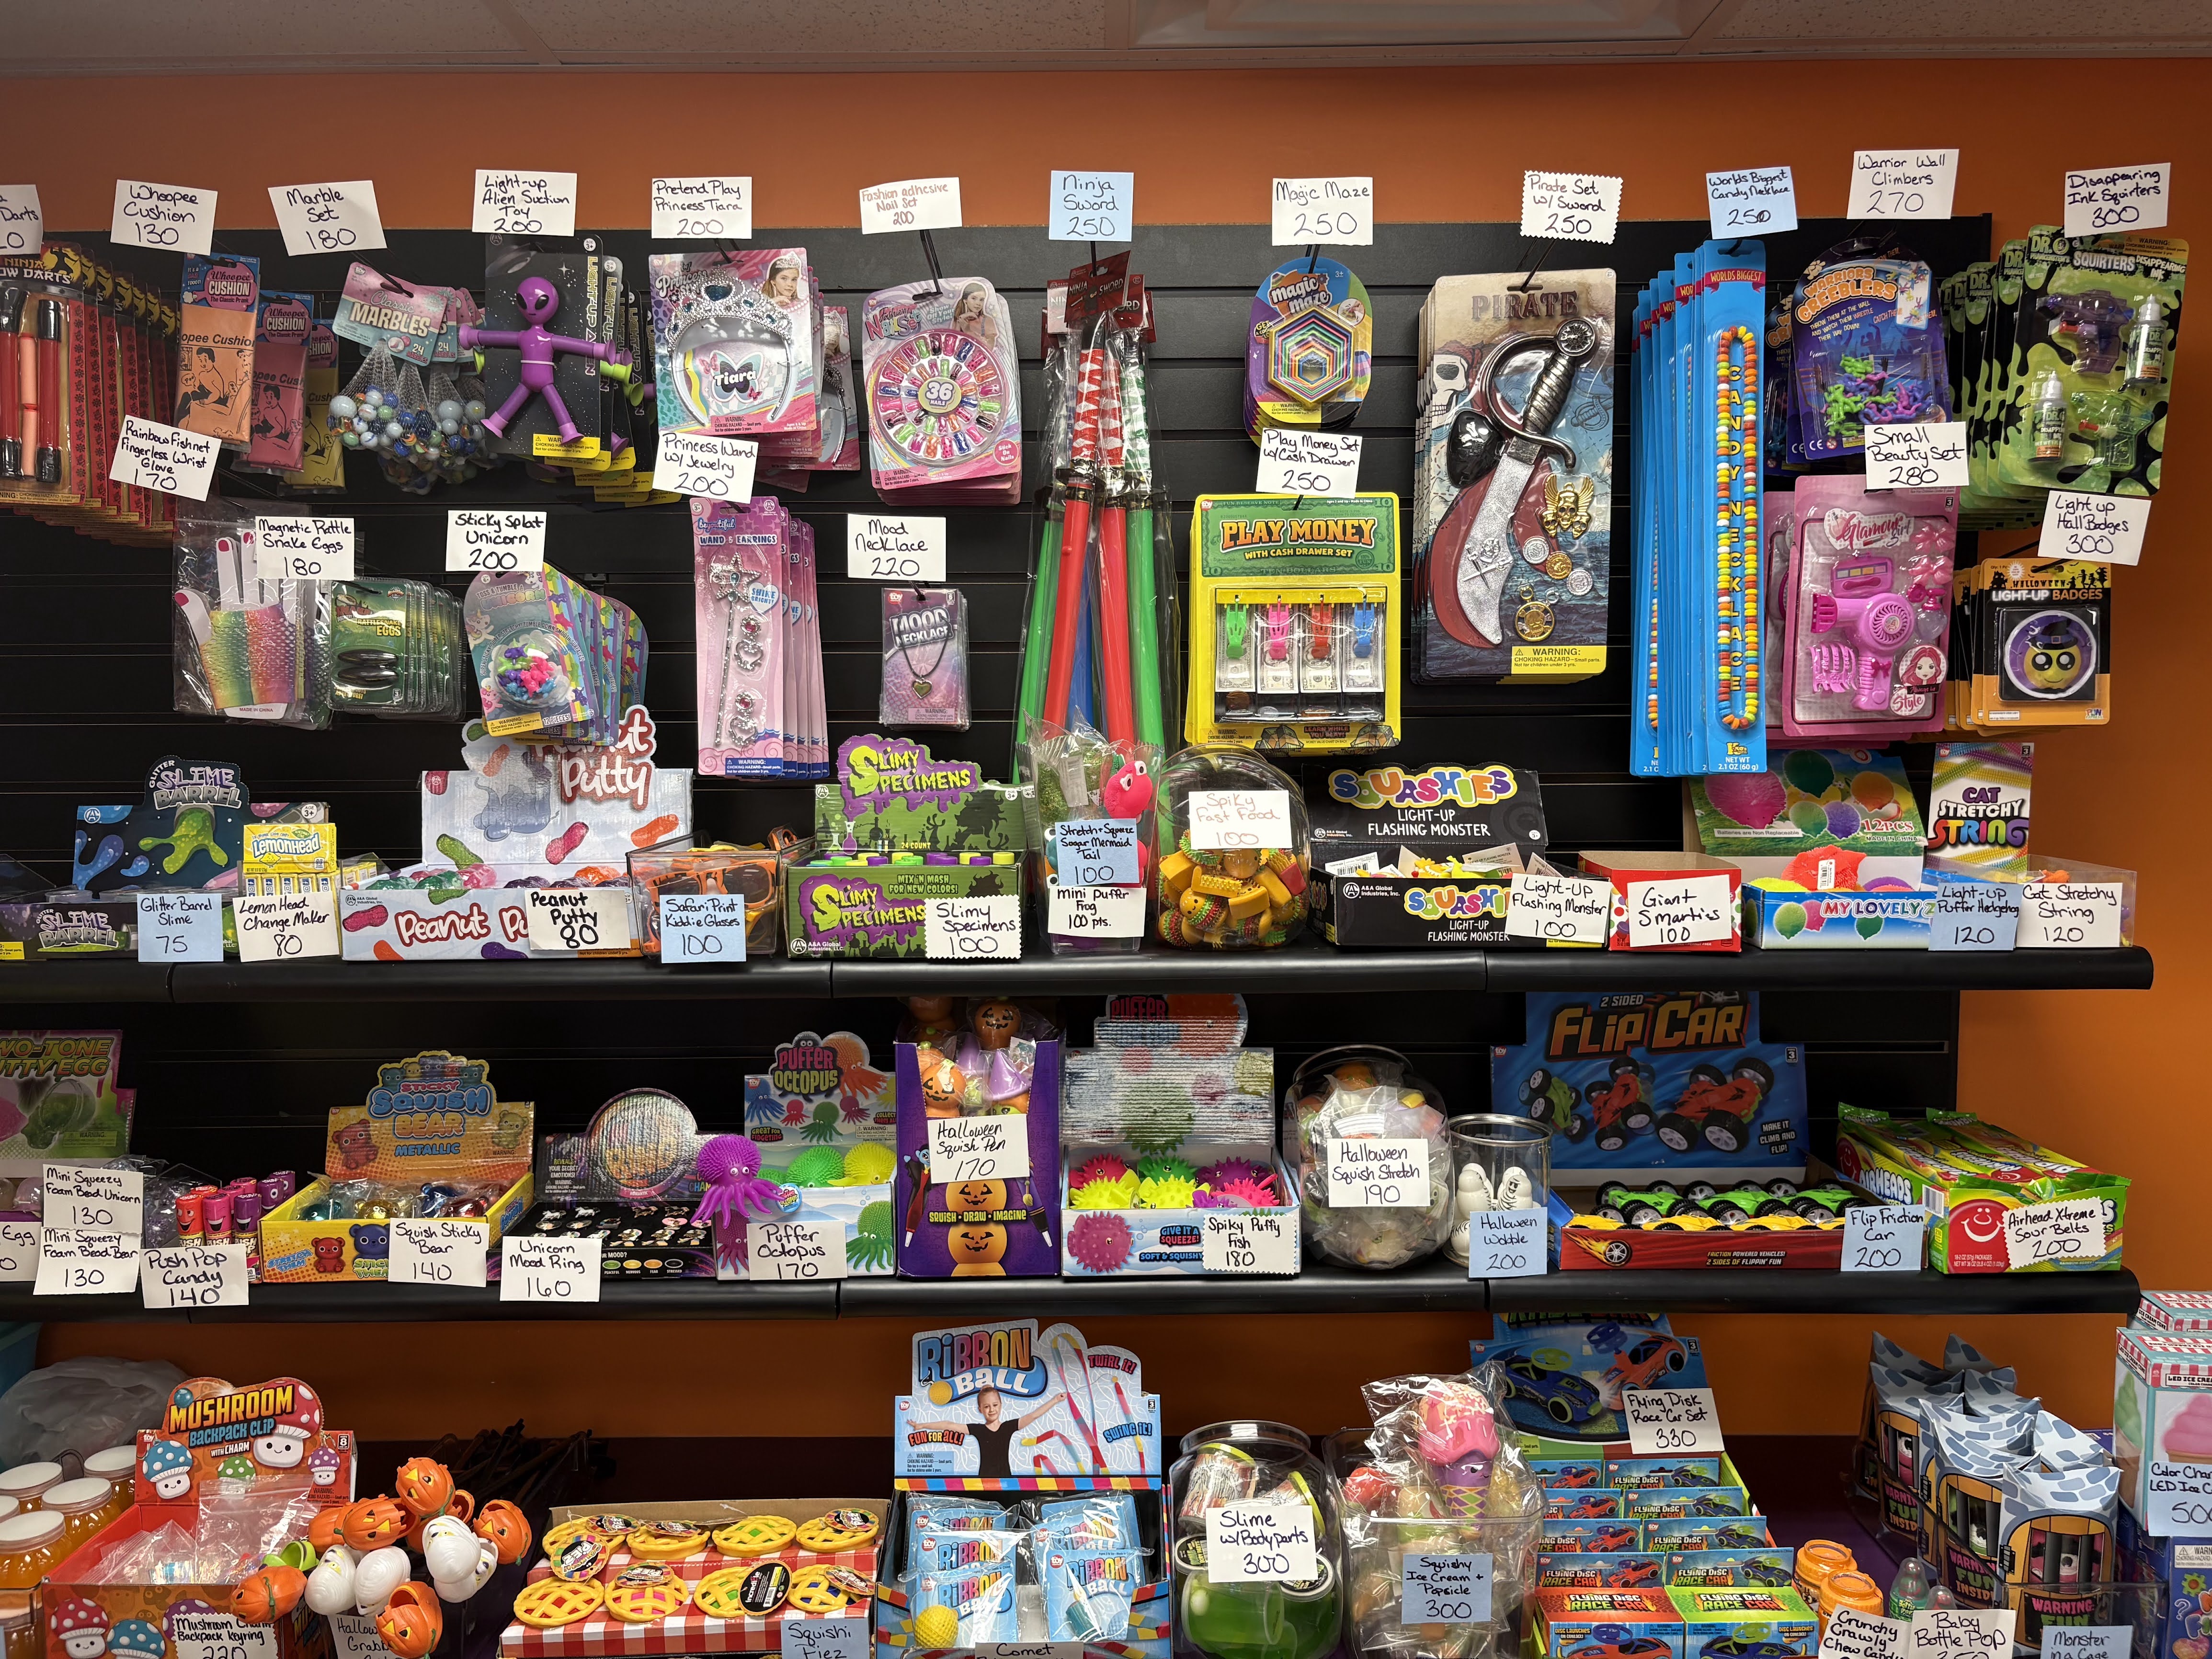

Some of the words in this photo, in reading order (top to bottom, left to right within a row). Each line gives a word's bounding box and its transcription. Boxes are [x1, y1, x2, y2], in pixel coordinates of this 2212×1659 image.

[1858, 154, 1907, 170] Warrior
[1917, 154, 1945, 167] Wall
[1872, 172, 1933, 185] Climbers
[2068, 170, 2160, 189] Disappearing
[129, 189, 199, 205] Whoopee
[287, 189, 344, 206] Marble
[653, 180, 708, 195] Pretend
[709, 180, 740, 200] Play
[1325, 181, 1369, 198] Maze
[2068, 192, 2098, 205] Ink
[2101, 185, 2160, 205] Squirters
[653, 197, 706, 212] Princess
[708, 198, 742, 211] Tiara
[1867, 191, 1924, 214] 270
[124, 202, 195, 222] Cushion
[308, 208, 339, 222] Set
[2093, 206, 2139, 228] 300
[677, 219, 723, 236] 200
[1294, 213, 1357, 235] 250
[136, 223, 179, 245] 130
[307, 228, 356, 249] 180
[2073, 251, 2136, 271] SQUIRTERS
[2136, 256, 2185, 273] DISAPPEARING
[210, 269, 250, 282] Whoopee
[1710, 272, 1735, 282] WORLDS
[1737, 271, 1762, 281] BIGGEST
[1805, 267, 1873, 297] WARRIORS
[208, 281, 250, 296] CUSHION
[371, 290, 414, 313] Classic
[1471, 290, 1578, 321] PIRATE
[1798, 281, 1898, 322] CREEBLERS
[350, 302, 431, 337] MARBLES
[713, 370, 756, 387] Tiara
[925, 385, 951, 400] 36
[259, 520, 311, 534] Magnetic
[314, 521, 352, 534] Rattle
[1222, 523, 1283, 548] PLAY
[1290, 519, 1376, 545] MONEY
[263, 536, 307, 549] Snake
[313, 538, 344, 552] Eggs
[699, 536, 724, 545] WAND
[736, 534, 777, 545] EARRINGS
[1244, 551, 1268, 559] WITH
[1270, 548, 1293, 557] CASH
[285, 558, 321, 577] 180
[2012, 580, 2065, 589] HALLOWEEN
[1728, 500, 1743, 691] NECKLACE
[1992, 590, 2049, 601] LIGHT-UP
[2052, 589, 2102, 600] BADGES
[1533, 648, 1581, 656] WARNING:
[149, 760, 174, 788] GLITTER
[157, 767, 235, 789] SLIME
[154, 787, 241, 809] BARREL
[1962, 787, 2000, 803] CAT
[1398, 809, 1455, 822] LIGHT-UP
[1939, 799, 2024, 817] STRETCHY
[1368, 824, 1427, 836] FLASHING
[1431, 824, 1490, 837] MONSTER
[1928, 818, 2029, 846] STRING
[898, 875, 914, 884] MIX
[925, 874, 949, 884] MASH
[889, 885, 904, 893] FOR
[906, 885, 925, 893] NEW
[927, 884, 958, 893] COLORS!
[399, 906, 487, 942] Peanut
[1601, 996, 1608, 1006] 2
[1549, 1007, 1644, 1056] FLIP
[1651, 1001, 1744, 1048] CAR
[779, 1047, 834, 1071] PUFFER
[395, 1143, 460, 1156] METALLIC
[1341, 1142, 1407, 1162] Halloween
[47, 1169, 70, 1183] Mini
[74, 1170, 122, 1187] Squeezy
[1332, 1166, 1375, 1184] Squish
[1378, 1164, 1420, 1180] Stretch
[46, 1183, 71, 1198] Foam
[74, 1186, 100, 1197] Bead
[103, 1188, 141, 1204] Unicorn
[1364, 1184, 1401, 1204] 190
[73, 1206, 113, 1225] 130
[929, 1212, 956, 1222] SQUISH
[964, 1211, 987, 1222] DRAW
[993, 1210, 1026, 1221] IMAGINE
[520, 1241, 574, 1254] Unicorn
[510, 1256, 544, 1268] Mood
[549, 1256, 585, 1273] Ring
[526, 1277, 571, 1298] 160
[170, 1386, 293, 1432] MUSHROOM
[1628, 1394, 1665, 1413] Flying
[1666, 1393, 1701, 1406] Disk
[1631, 1409, 1662, 1423] Race
[1667, 1410, 1682, 1421] Car
[1686, 1409, 1709, 1420] Set
[1656, 1429, 1696, 1448] 330
[211, 1448, 224, 1456] WITH
[225, 1442, 250, 1455] CHARM
[1220, 1511, 1276, 1528] Slime
[1244, 1553, 1289, 1574] 300
[1420, 1558, 1471, 1572] Squishy
[1407, 1572, 1428, 1581] Ice
[1431, 1573, 1471, 1582] Cream
[1417, 1583, 1471, 1596] Popsicle
[1426, 1600, 1472, 1619] 300
[2032, 1597, 2093, 1613] WARNING
[1931, 1612, 1980, 1631] Baby
[1916, 1626, 1962, 1647] Bottle
[2054, 1632, 2109, 1646] Monster
